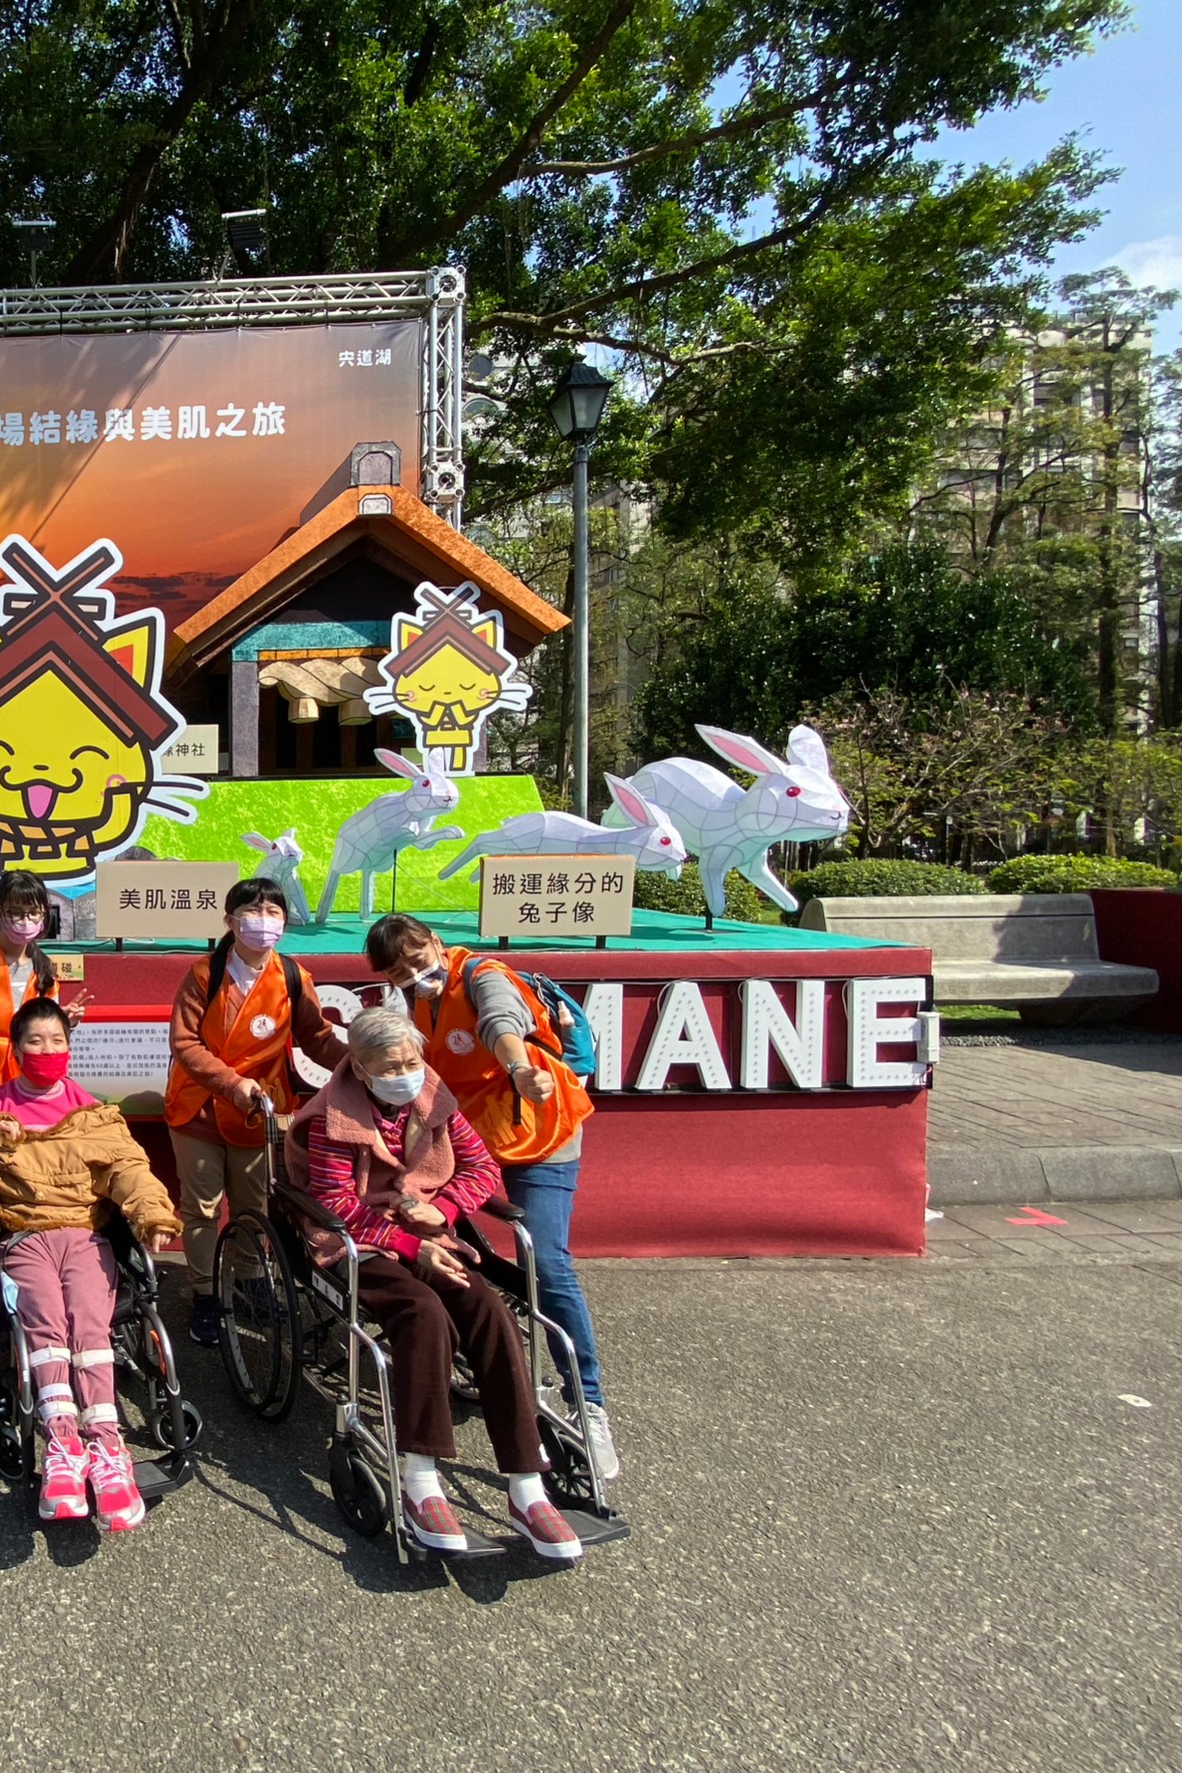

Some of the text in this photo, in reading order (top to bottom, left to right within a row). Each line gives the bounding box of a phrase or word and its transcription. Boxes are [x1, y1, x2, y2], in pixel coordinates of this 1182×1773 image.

[492, 872, 624, 895] 搬運緣分的
[120, 889, 217, 910] 美肌溫泉
[518, 901, 595, 923] 兔子像
